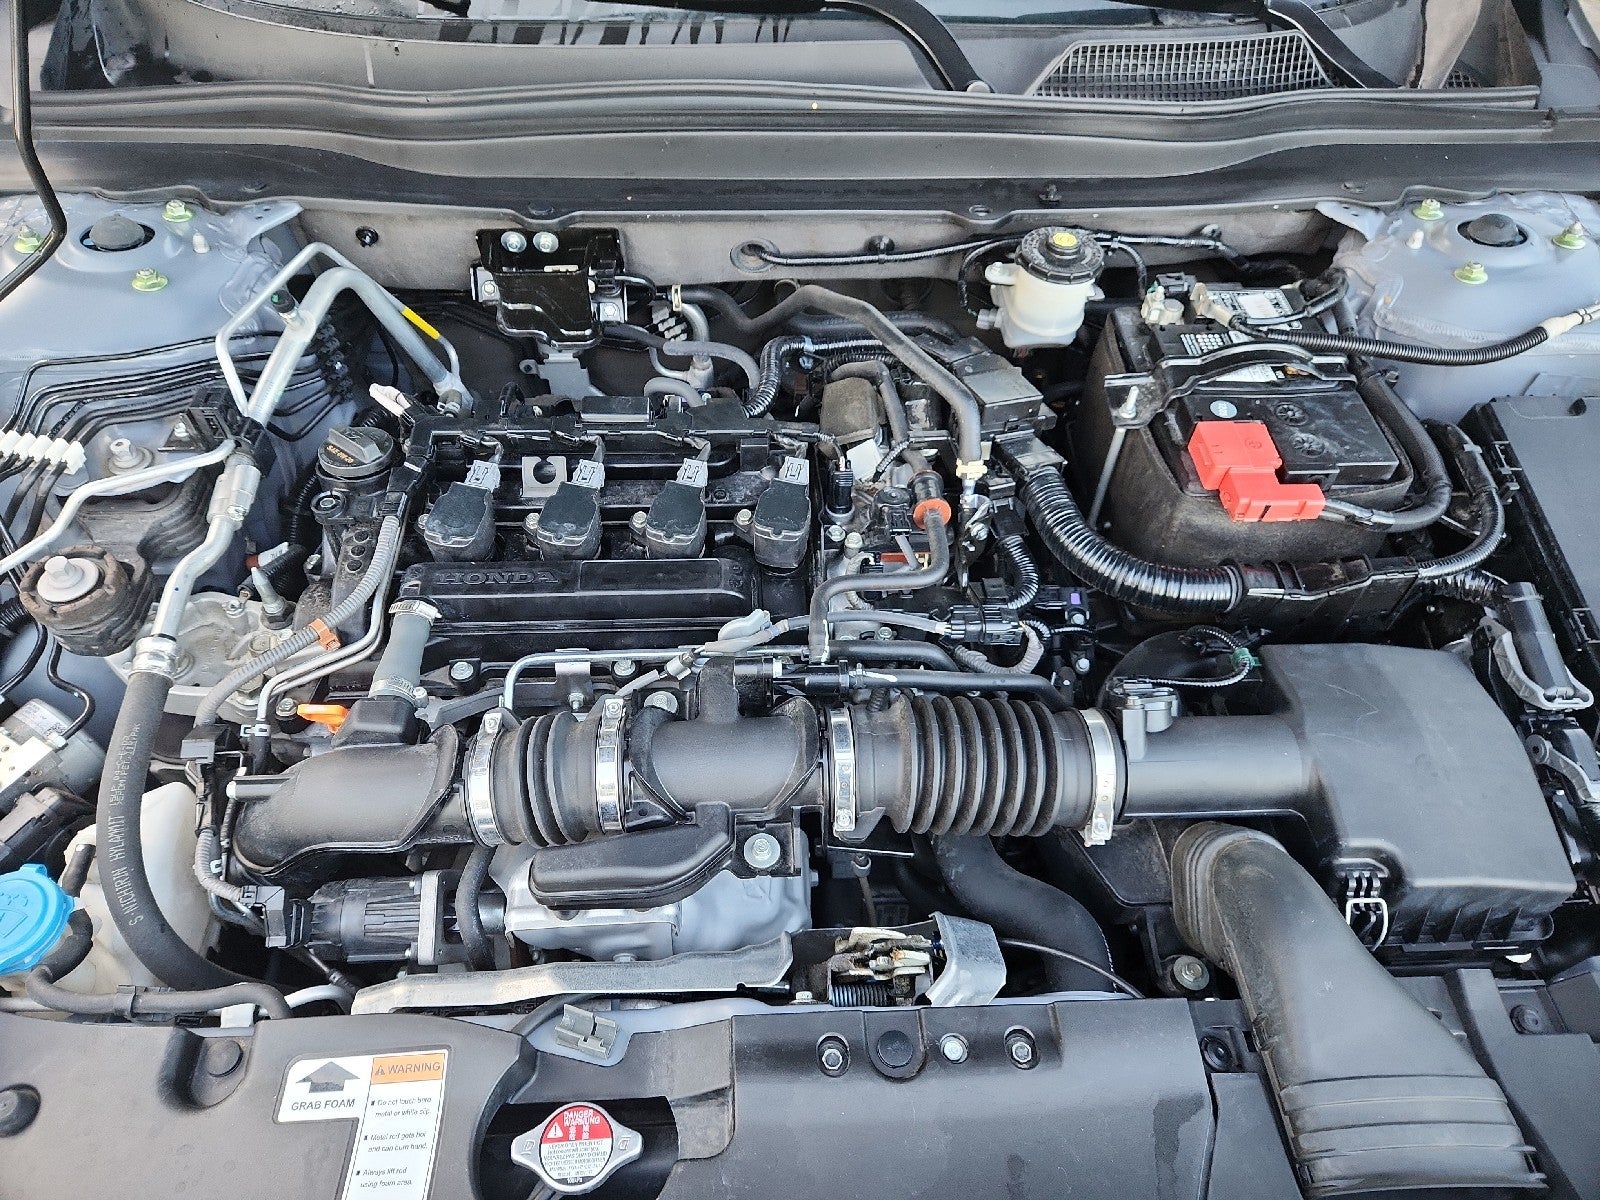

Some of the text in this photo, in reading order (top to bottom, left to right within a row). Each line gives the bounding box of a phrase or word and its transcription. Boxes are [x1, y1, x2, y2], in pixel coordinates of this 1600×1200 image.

[435, 569, 559, 585] HONDA
[388, 1061, 441, 1074] WARNING
[291, 1098, 356, 1111] GRAB FOAM
[563, 1109, 594, 1119] DANGER
[362, 1168, 386, 1177] Always
[396, 1167, 408, 1175] rod
[360, 1180, 378, 1189] using
[379, 1179, 396, 1187] foam
